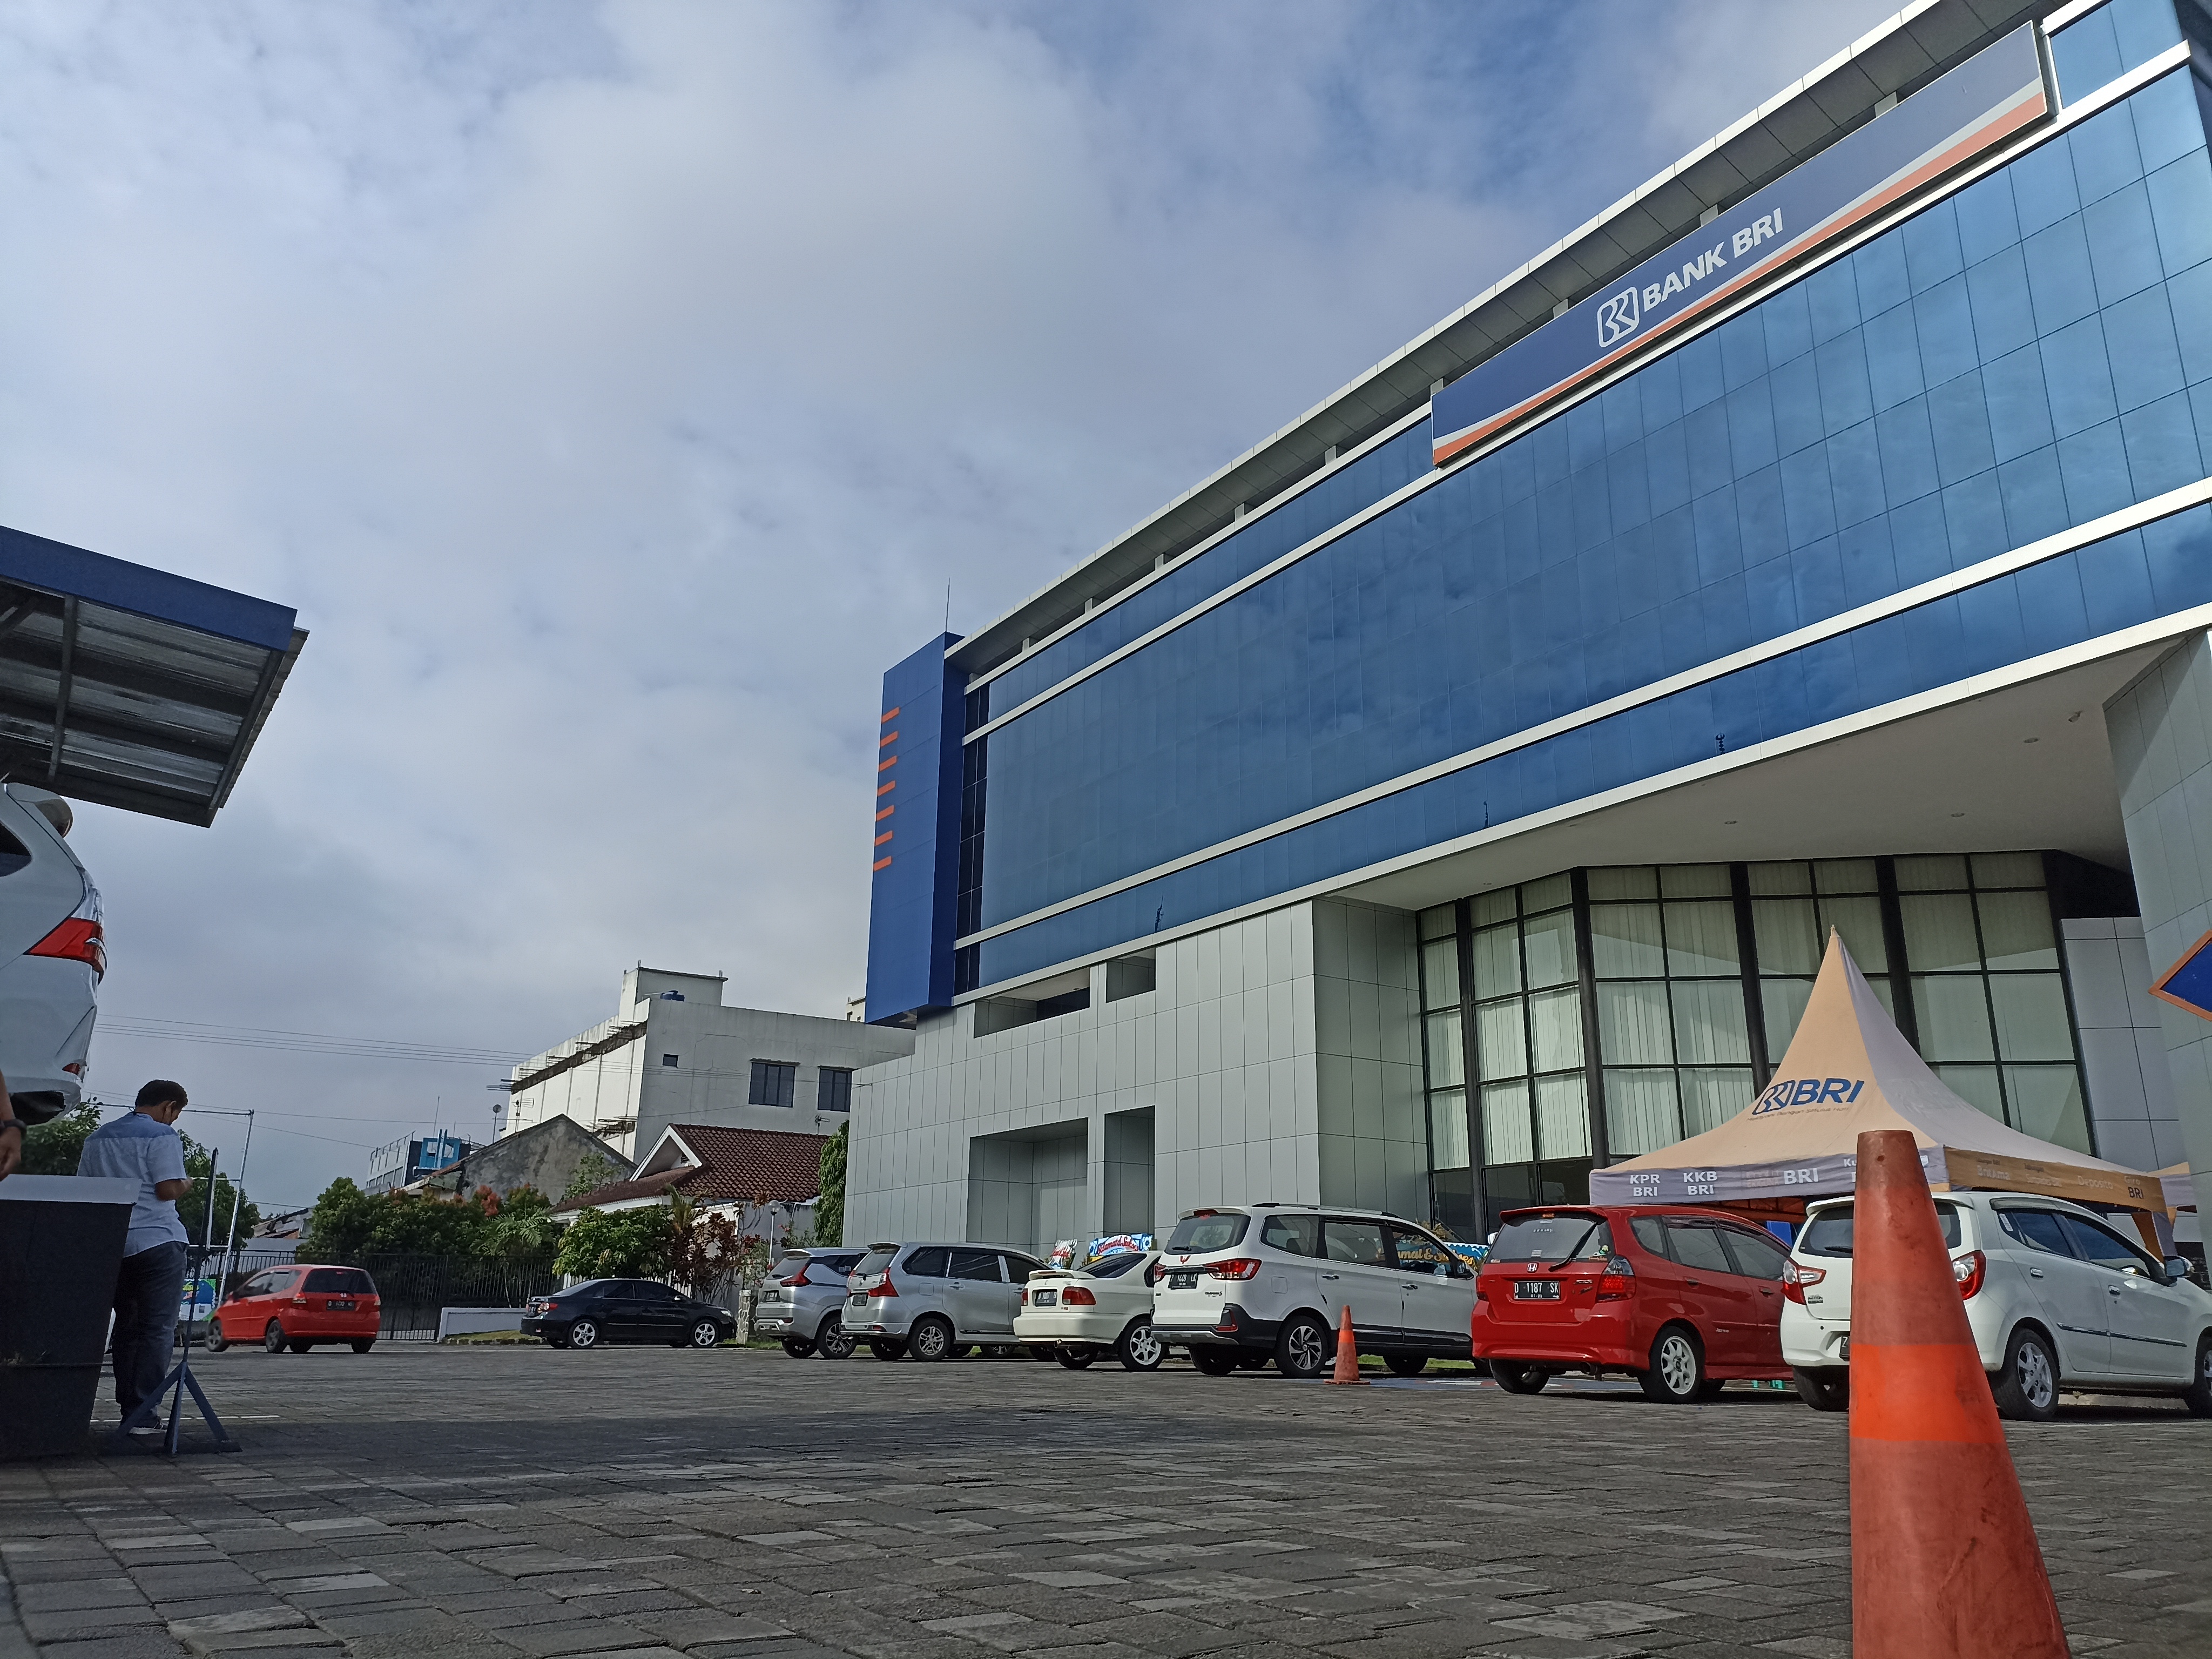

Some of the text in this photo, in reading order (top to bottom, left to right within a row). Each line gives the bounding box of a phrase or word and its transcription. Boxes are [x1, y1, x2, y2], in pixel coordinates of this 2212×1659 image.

[1643, 207, 1783, 312] BANK BRI
[1790, 1078, 1864, 1105] BRI
[1630, 1174, 1661, 1184] KPR
[1683, 1171, 1718, 1183] KKB
[1784, 1168, 1819, 1184] BRI
[2078, 1175, 2113, 1189] Deposito
[2124, 1176, 2141, 1185] Giro
[1633, 1187, 1657, 1197] BRI
[1688, 1185, 1714, 1195] BRI
[2128, 1187, 2144, 1199] BRI
[1514, 1282, 1559, 1293] D 1187 SK
[1842, 1336, 1848, 1348] Z
